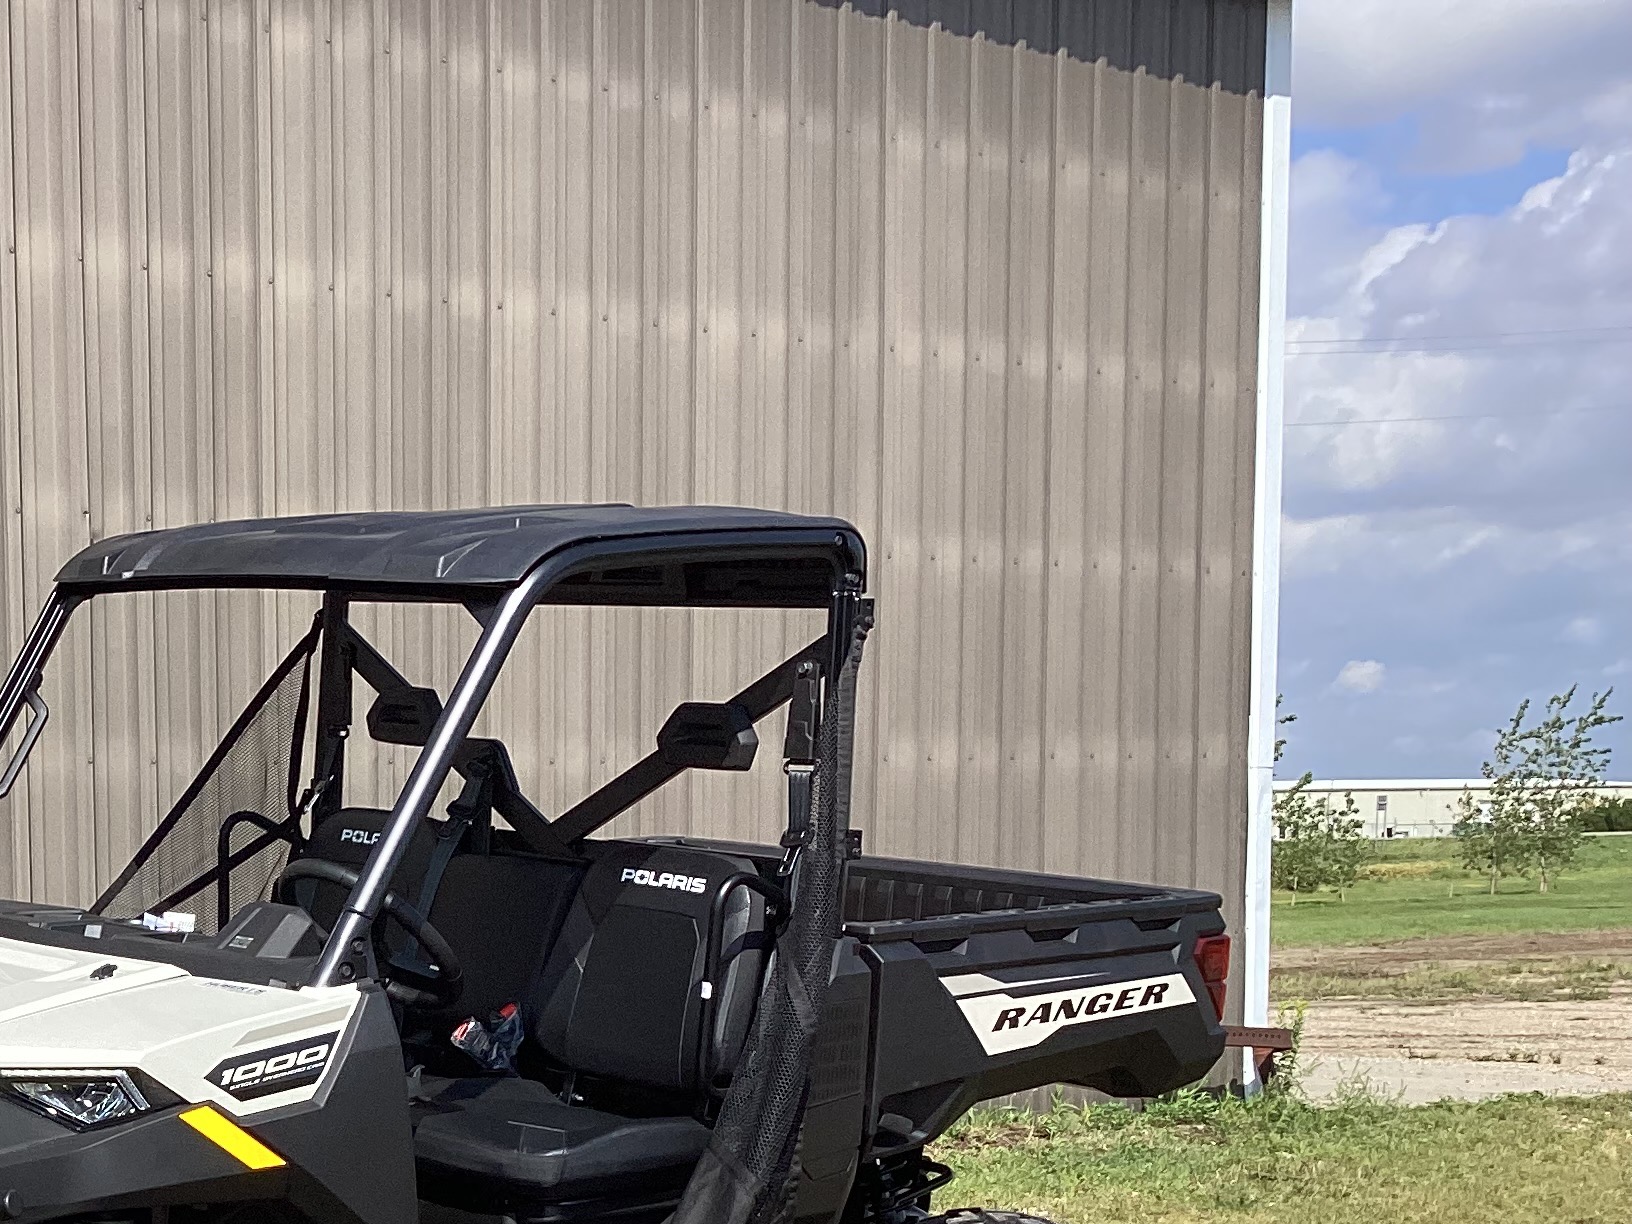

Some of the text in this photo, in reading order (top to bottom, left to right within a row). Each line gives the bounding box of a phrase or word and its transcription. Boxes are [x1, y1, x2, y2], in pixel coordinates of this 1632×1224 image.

[621, 868, 707, 893] POLARIS
[992, 983, 1169, 1032] RANGER
[220, 1043, 329, 1086] 1000
